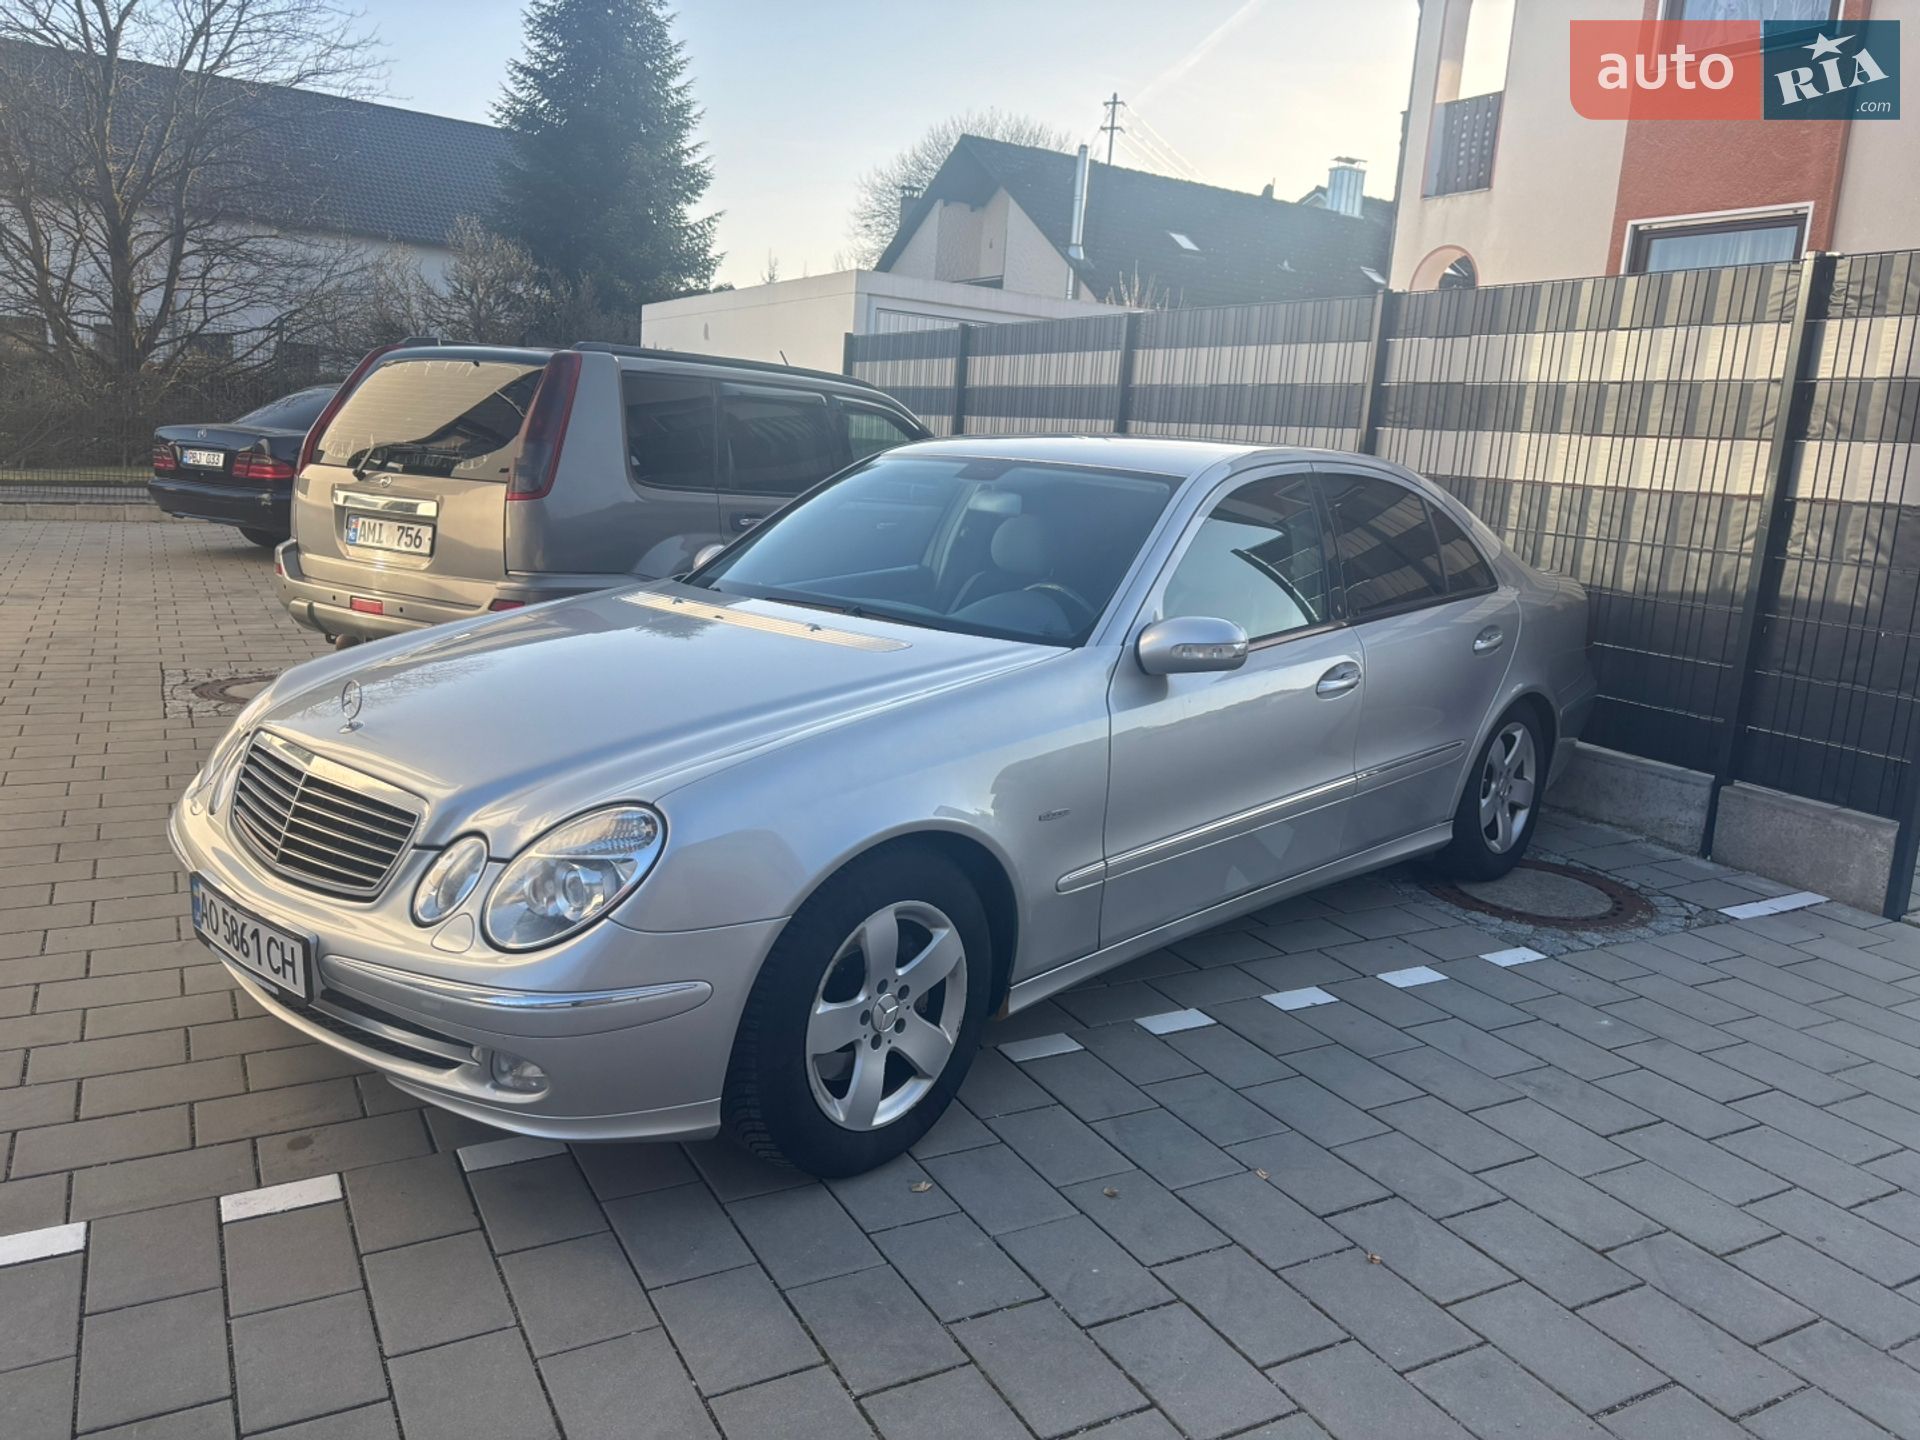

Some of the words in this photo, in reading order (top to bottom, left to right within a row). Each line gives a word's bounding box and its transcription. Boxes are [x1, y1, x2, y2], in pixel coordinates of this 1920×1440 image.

[358, 520, 384, 544] AMI
[396, 525, 423, 549] 756
[201, 891, 219, 936] AO
[222, 907, 262, 966] 5861
[266, 935, 297, 986] CH
